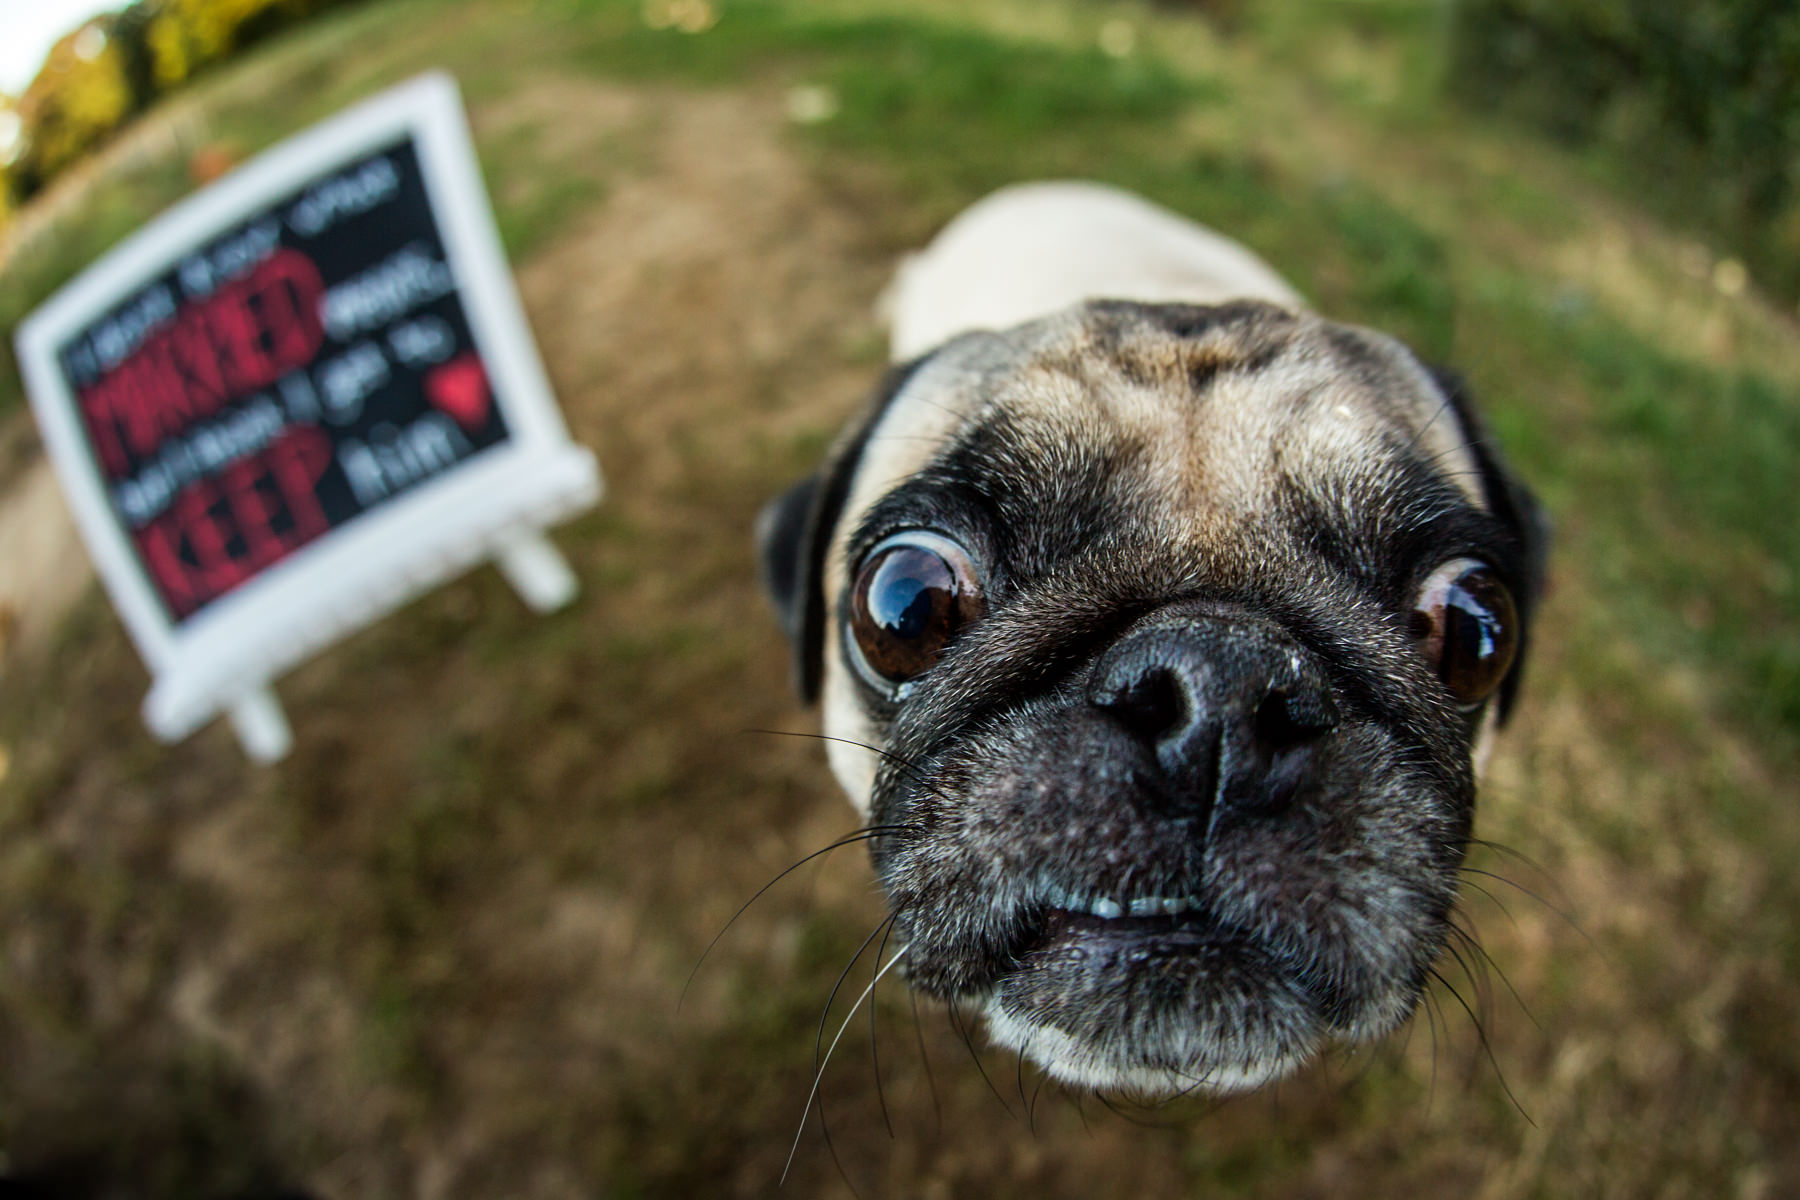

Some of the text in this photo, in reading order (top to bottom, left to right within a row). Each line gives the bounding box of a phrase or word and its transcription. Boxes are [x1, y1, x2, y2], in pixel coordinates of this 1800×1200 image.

[318, 339, 389, 425] get
[386, 317, 455, 367] to
[135, 413, 475, 622] KEEP him
